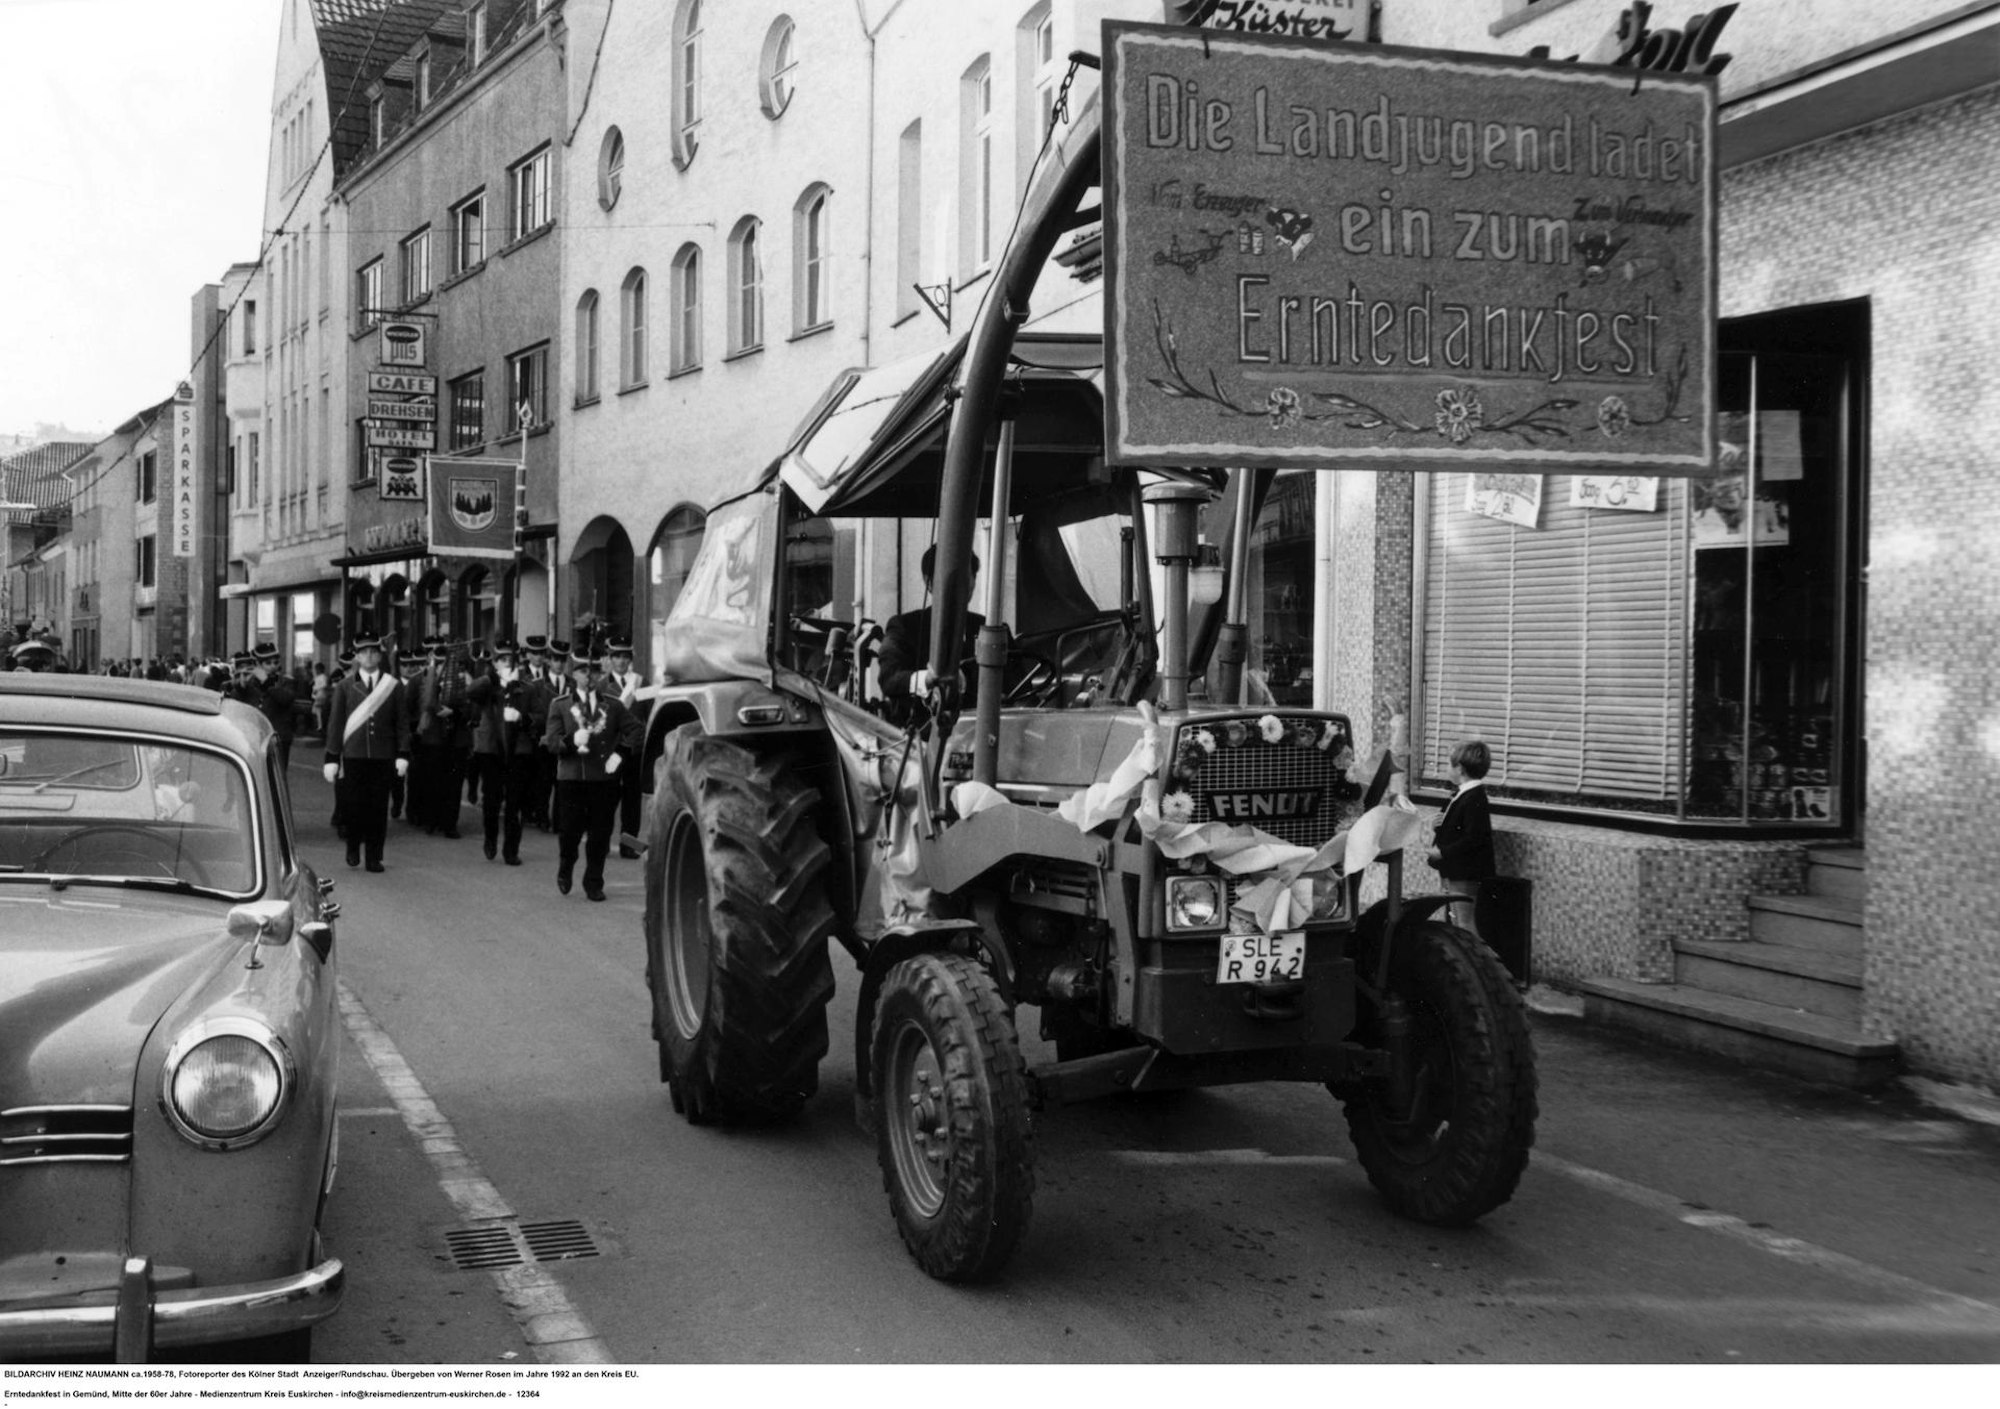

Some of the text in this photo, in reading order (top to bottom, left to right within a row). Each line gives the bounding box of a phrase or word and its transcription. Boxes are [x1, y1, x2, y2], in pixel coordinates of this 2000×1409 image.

[1147, 73, 1698, 184] Die Landjugend ladet
[1340, 188, 1571, 266] ein zum
[1236, 273, 1660, 384] Erntedankfest
[371, 403, 435, 419] DREHSEN
[375, 429, 430, 441] HOTEL
[180, 410, 191, 552] SPARKASSE
[1212, 792, 1319, 817] FENDT
[1242, 936, 1283, 958] SLE
[1226, 957, 1300, 980] R 942
